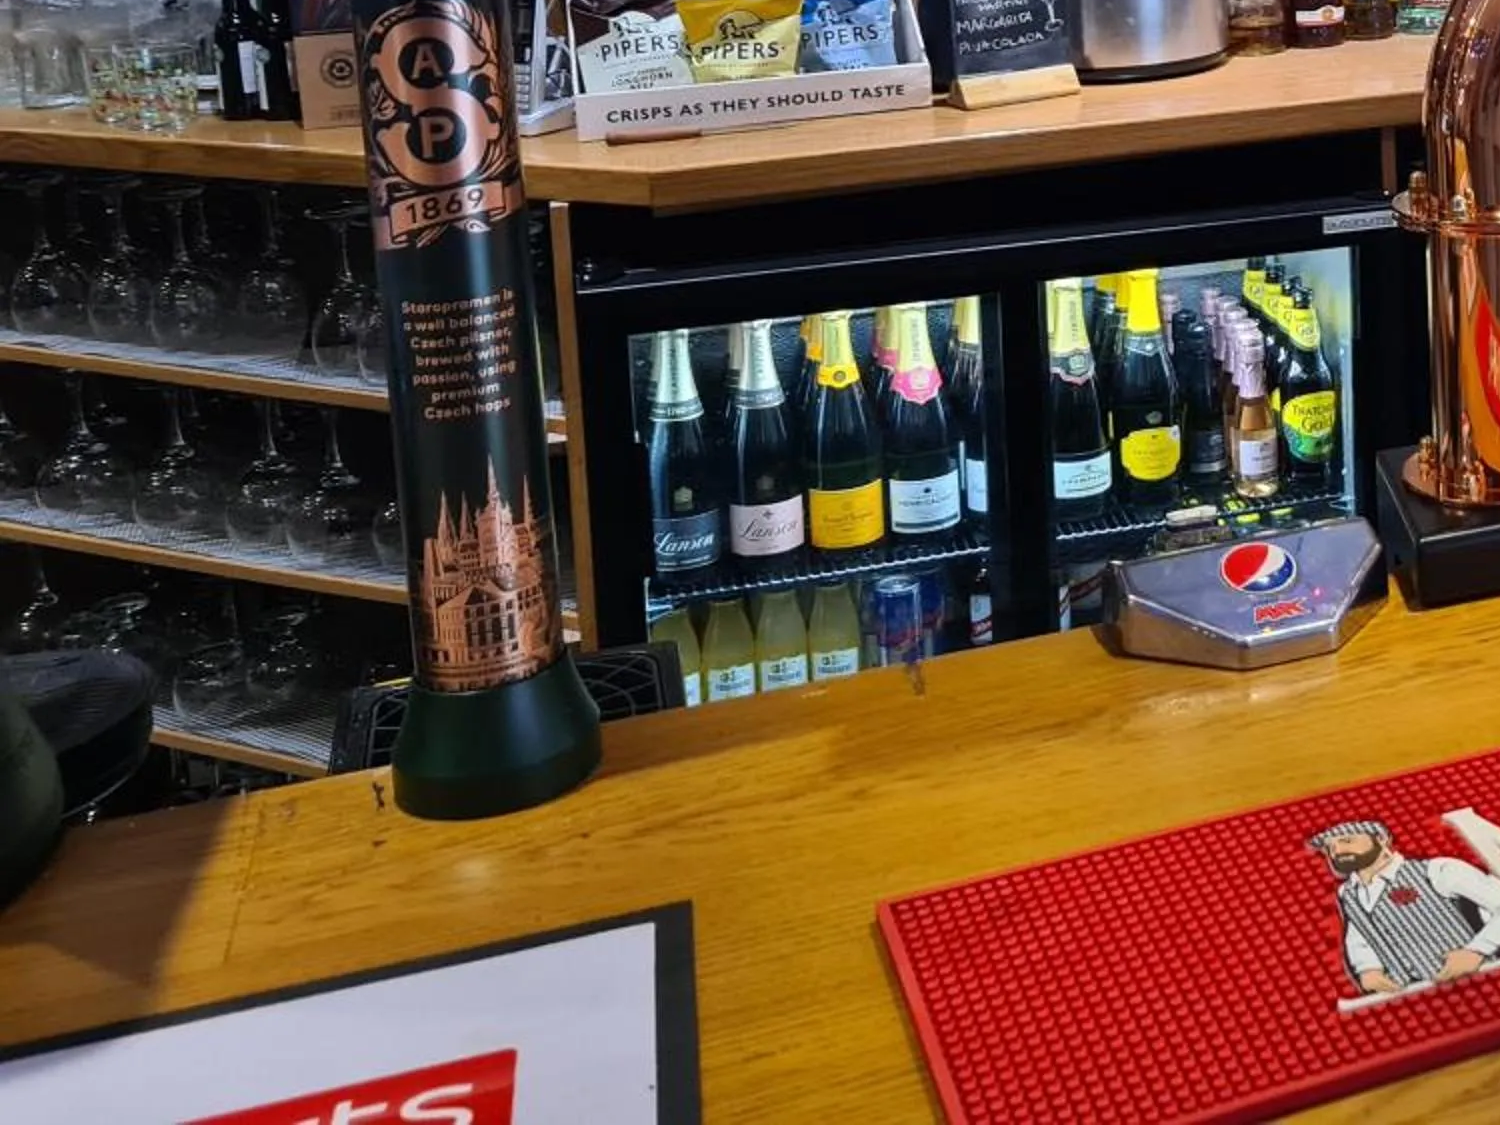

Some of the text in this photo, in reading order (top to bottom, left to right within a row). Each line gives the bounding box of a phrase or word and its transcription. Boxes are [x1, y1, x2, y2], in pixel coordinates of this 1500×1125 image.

[600, 33, 680, 63] PIPERS
[700, 40, 779, 63] PIPERS
[802, 24, 877, 51] PIPERS
[411, 42, 438, 79] A
[607, 83, 906, 123] CRISPS AS THEY SHOULD TASTE
[420, 117, 455, 159] P
[405, 187, 484, 224] 1869
[654, 530, 715, 556] Lanson
[739, 519, 799, 543] Lanson
